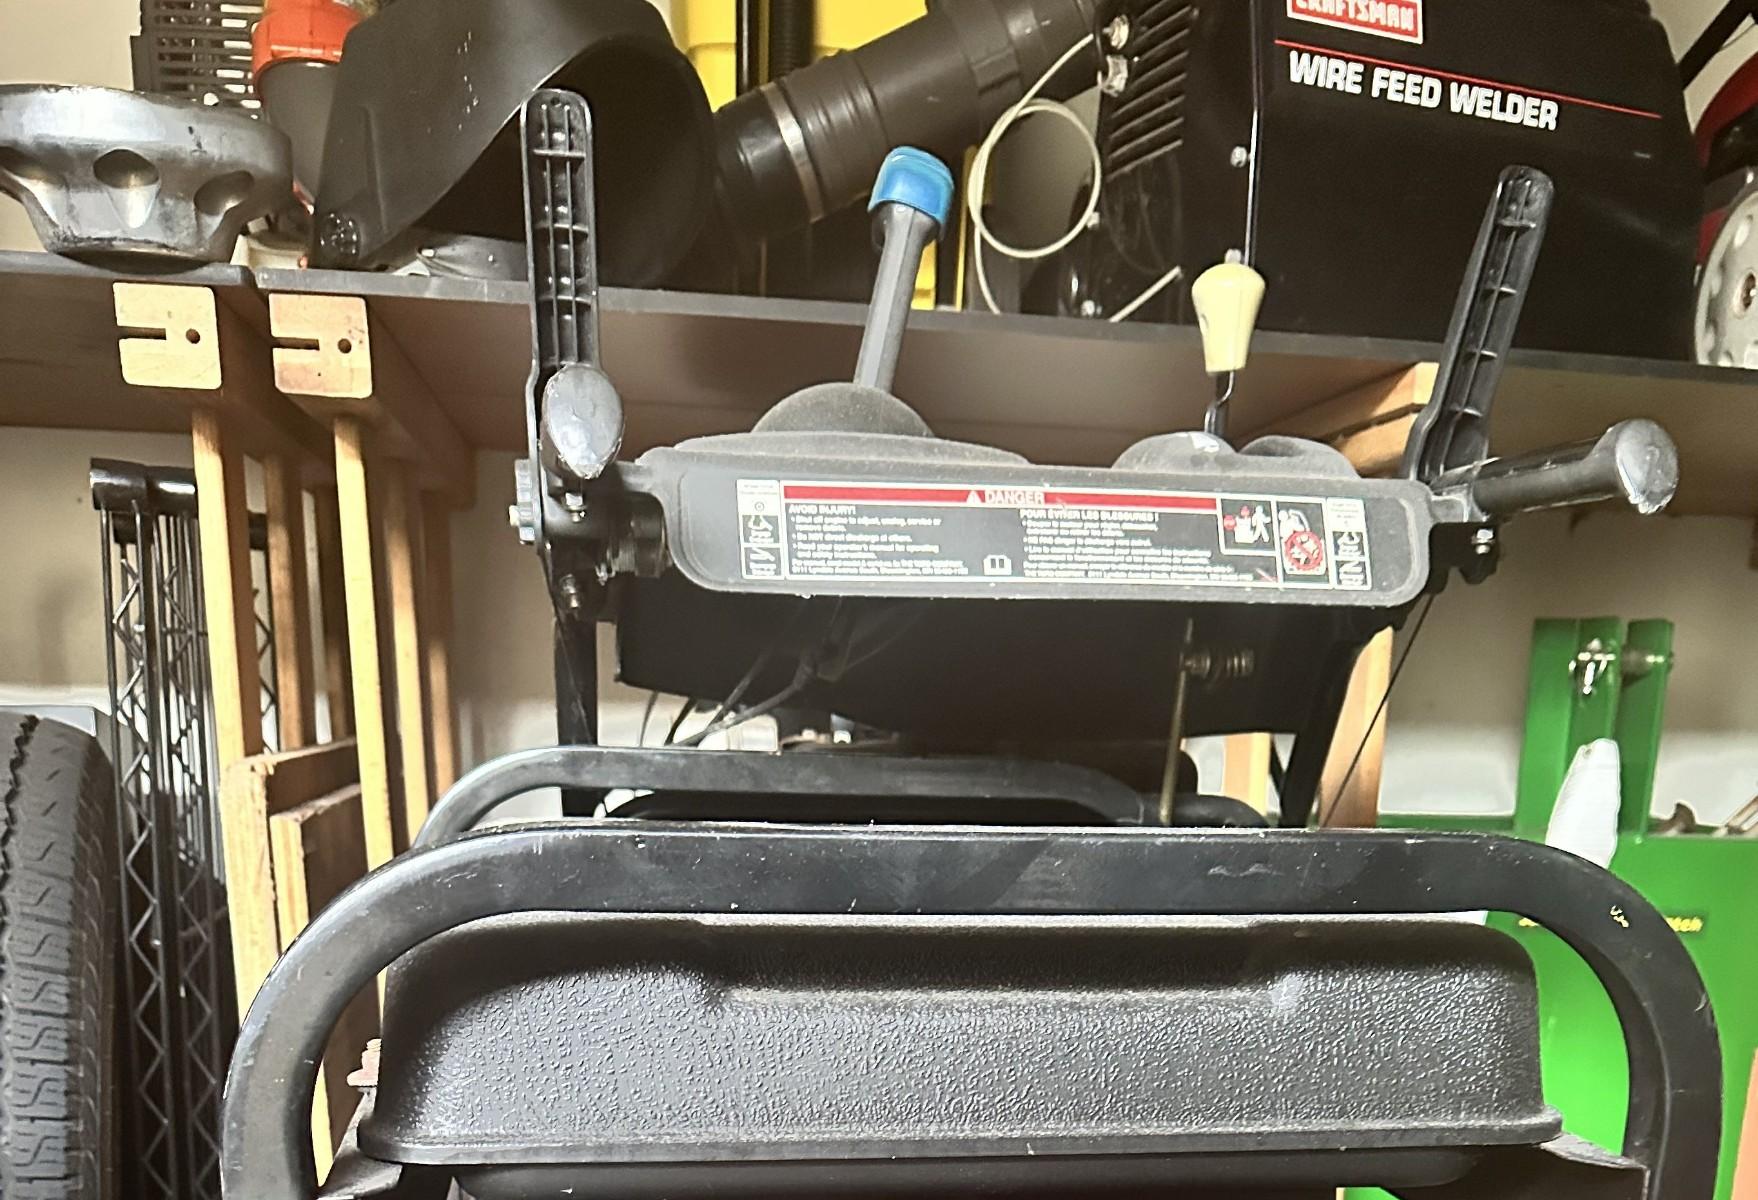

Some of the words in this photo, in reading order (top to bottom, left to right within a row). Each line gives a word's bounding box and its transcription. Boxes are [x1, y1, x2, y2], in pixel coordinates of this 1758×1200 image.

[1289, 50, 1364, 94] WIRE
[1371, 67, 1442, 108] FEED
[1450, 81, 1558, 130] WELDER
[984, 490, 1045, 505] DANGER
